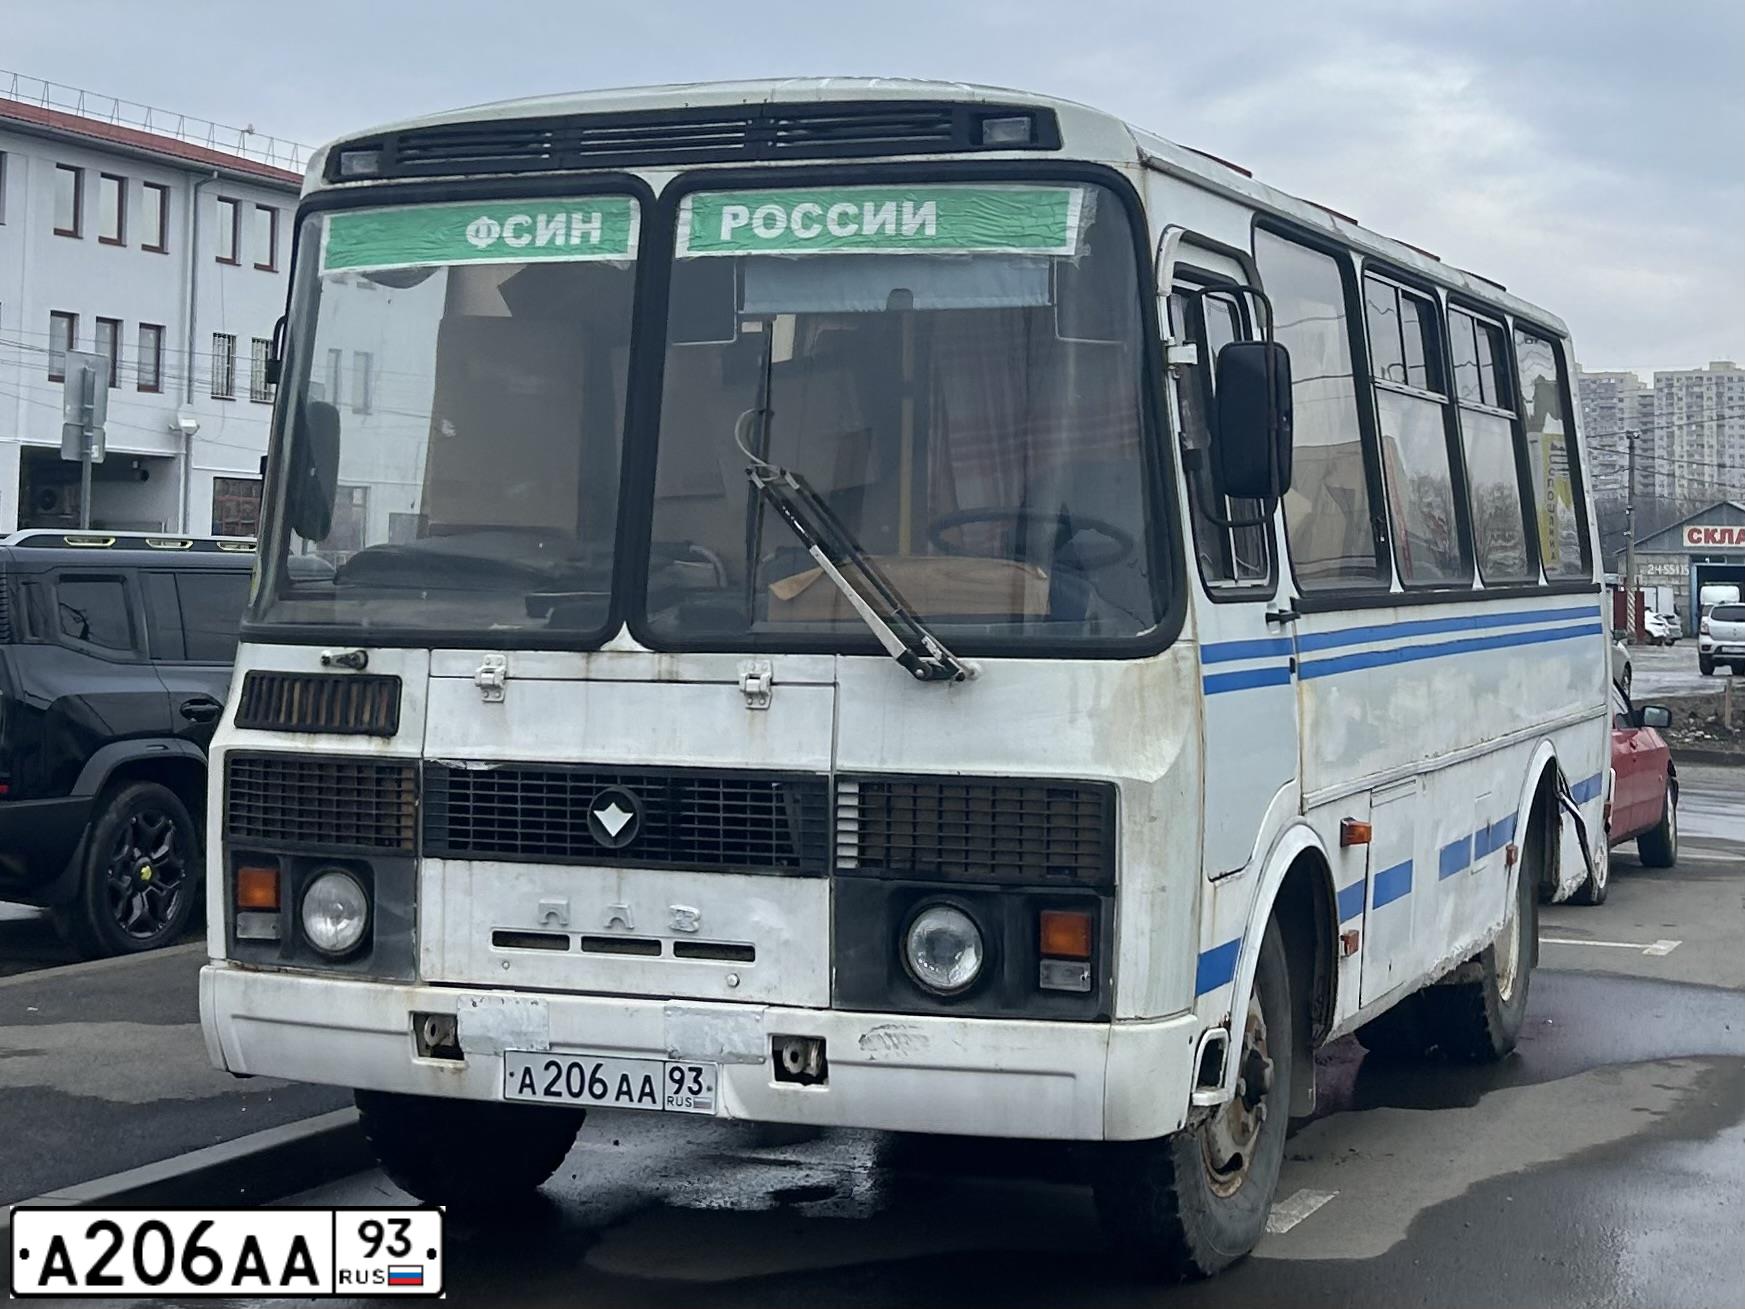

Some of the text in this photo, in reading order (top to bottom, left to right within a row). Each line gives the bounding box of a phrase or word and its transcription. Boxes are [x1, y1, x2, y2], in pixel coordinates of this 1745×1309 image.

[466, 201, 937, 249] ФСИН РОССИИ
[1687, 527, 1745, 545] СКЛА
[668, 1065, 704, 1096] 93
[666, 1096, 693, 1108] RUS
